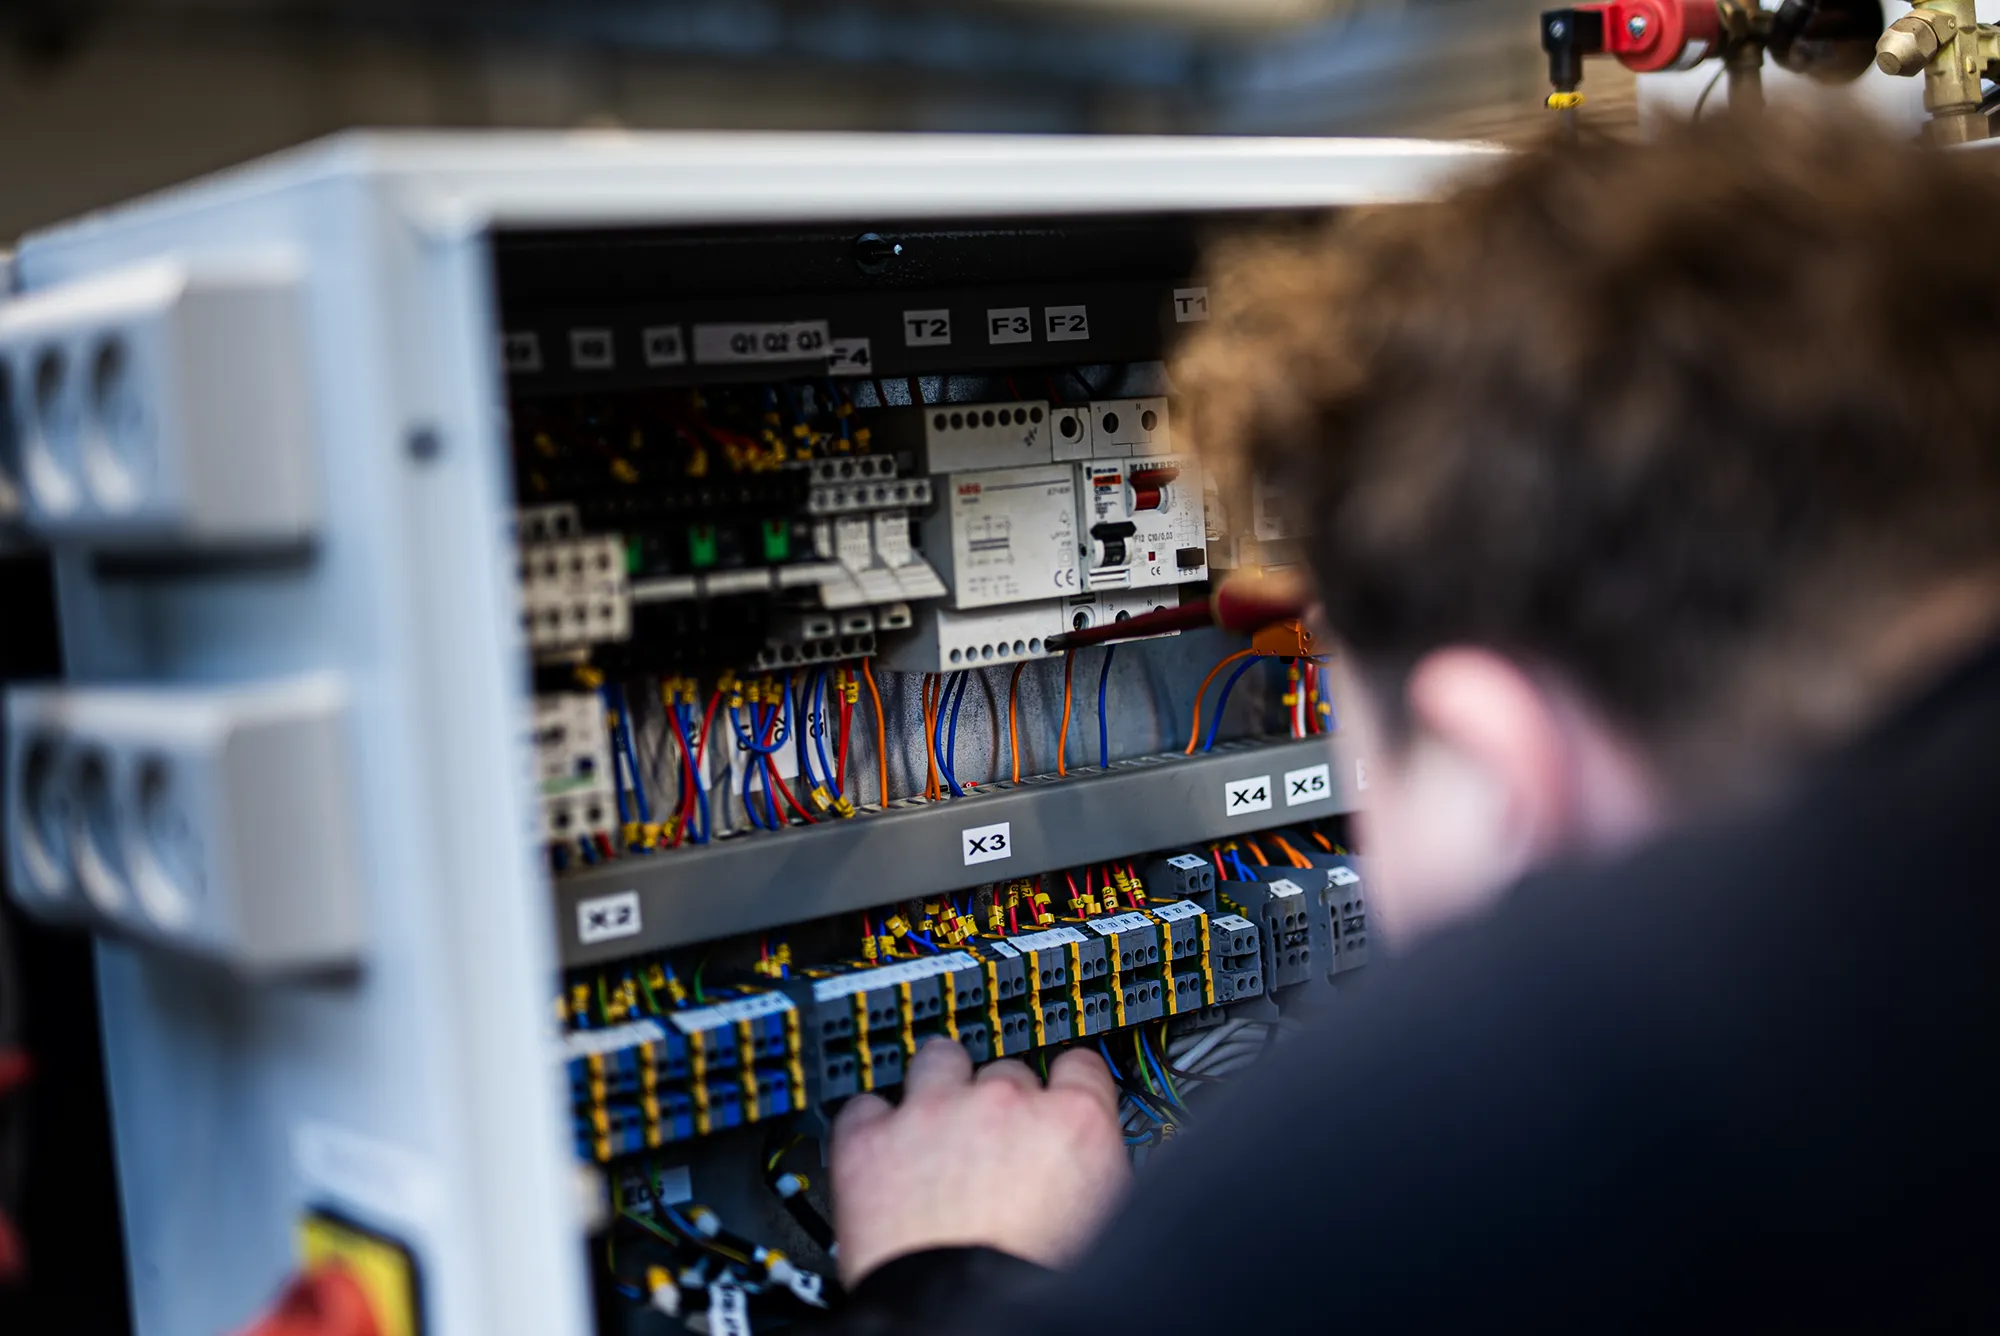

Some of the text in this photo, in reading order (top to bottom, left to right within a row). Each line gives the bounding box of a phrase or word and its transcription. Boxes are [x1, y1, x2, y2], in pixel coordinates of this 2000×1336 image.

[1175, 296, 1207, 314] T1
[907, 319, 948, 338] T2
[992, 316, 1029, 335] F3
[1049, 315, 1086, 333] F2
[731, 332, 757, 354] Q1
[797, 329, 822, 351] Q3
[1177, 567, 1200, 578] TEST
[1291, 776, 1325, 796] X5
[1232, 787, 1267, 807] X4
[968, 833, 1007, 856] X3
[588, 906, 631, 930] X2
